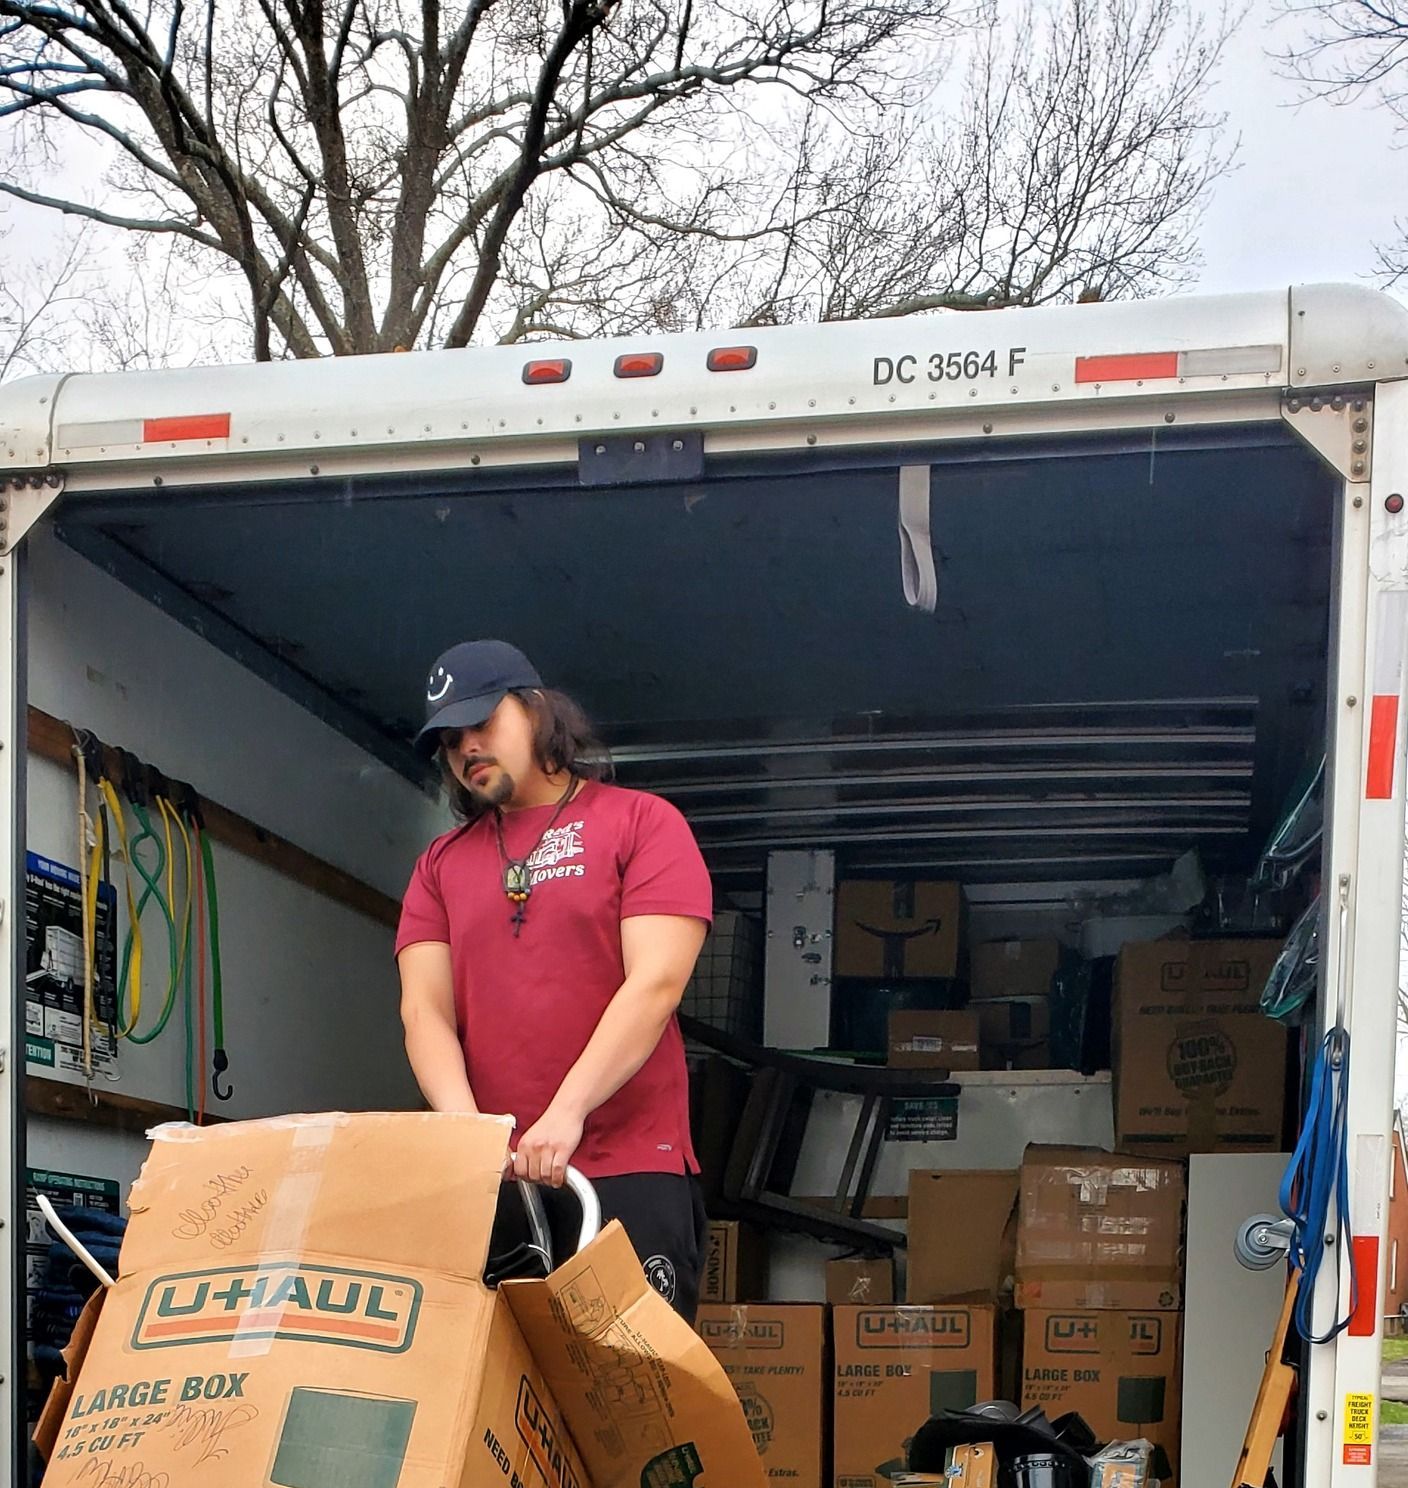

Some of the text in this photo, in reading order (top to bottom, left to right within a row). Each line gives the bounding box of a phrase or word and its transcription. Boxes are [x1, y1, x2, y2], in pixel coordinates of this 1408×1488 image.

[873, 347, 1027, 386] DC 3564 F
[837, 1365, 880, 1377] LARGE
[1025, 1369, 1100, 1382] LARGE BOX
[71, 1373, 250, 1419] LARGE BOX
[57, 1431, 146, 1461] 4.5 CU FT
[484, 1427, 511, 1475] NEED
